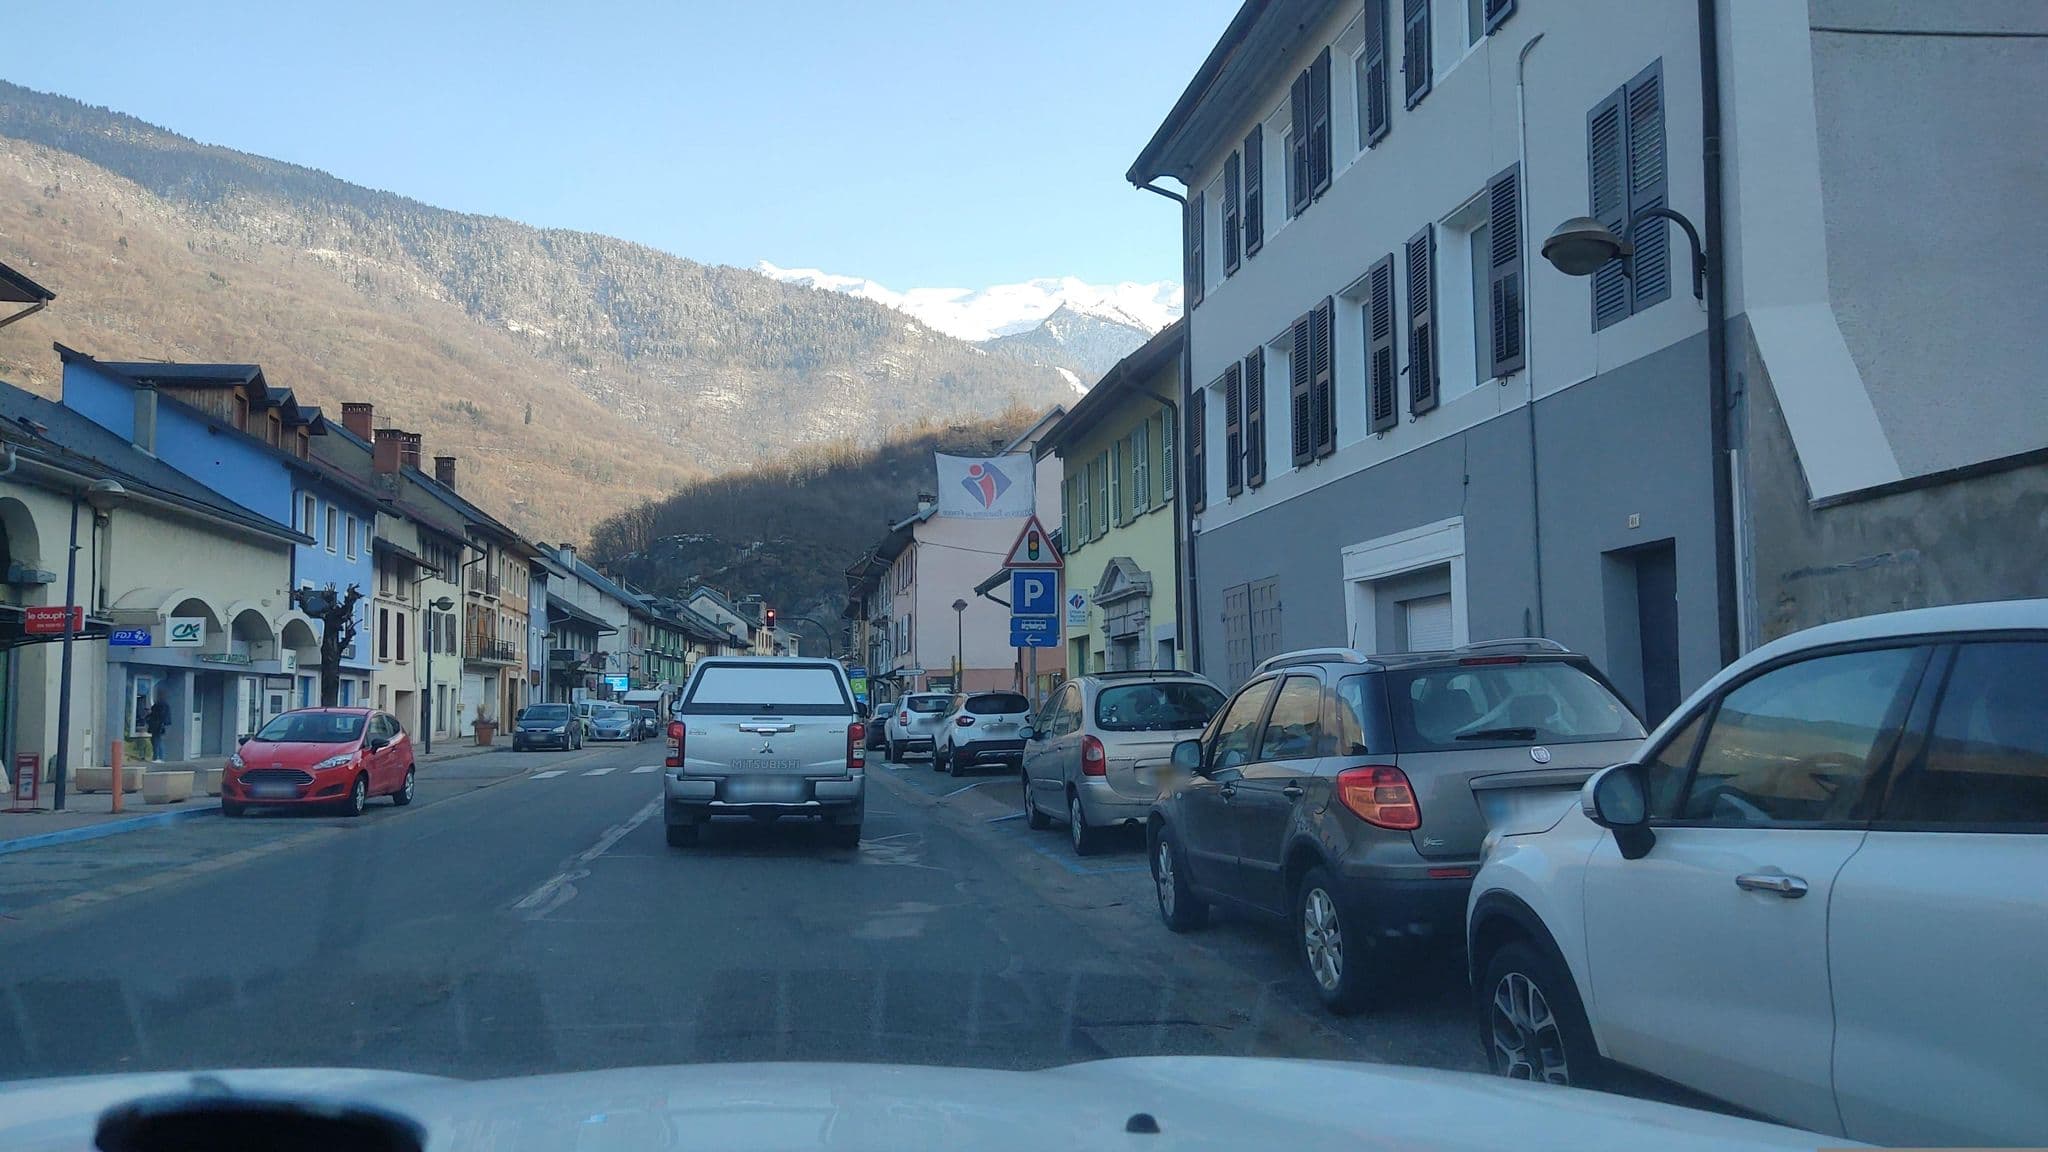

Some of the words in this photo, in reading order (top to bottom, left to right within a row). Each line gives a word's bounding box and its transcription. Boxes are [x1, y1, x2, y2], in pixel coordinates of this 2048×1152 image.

[1024, 578, 1044, 608] P
[115, 631, 132, 639] FDJ
[731, 758, 800, 770] MITSUBISHI
